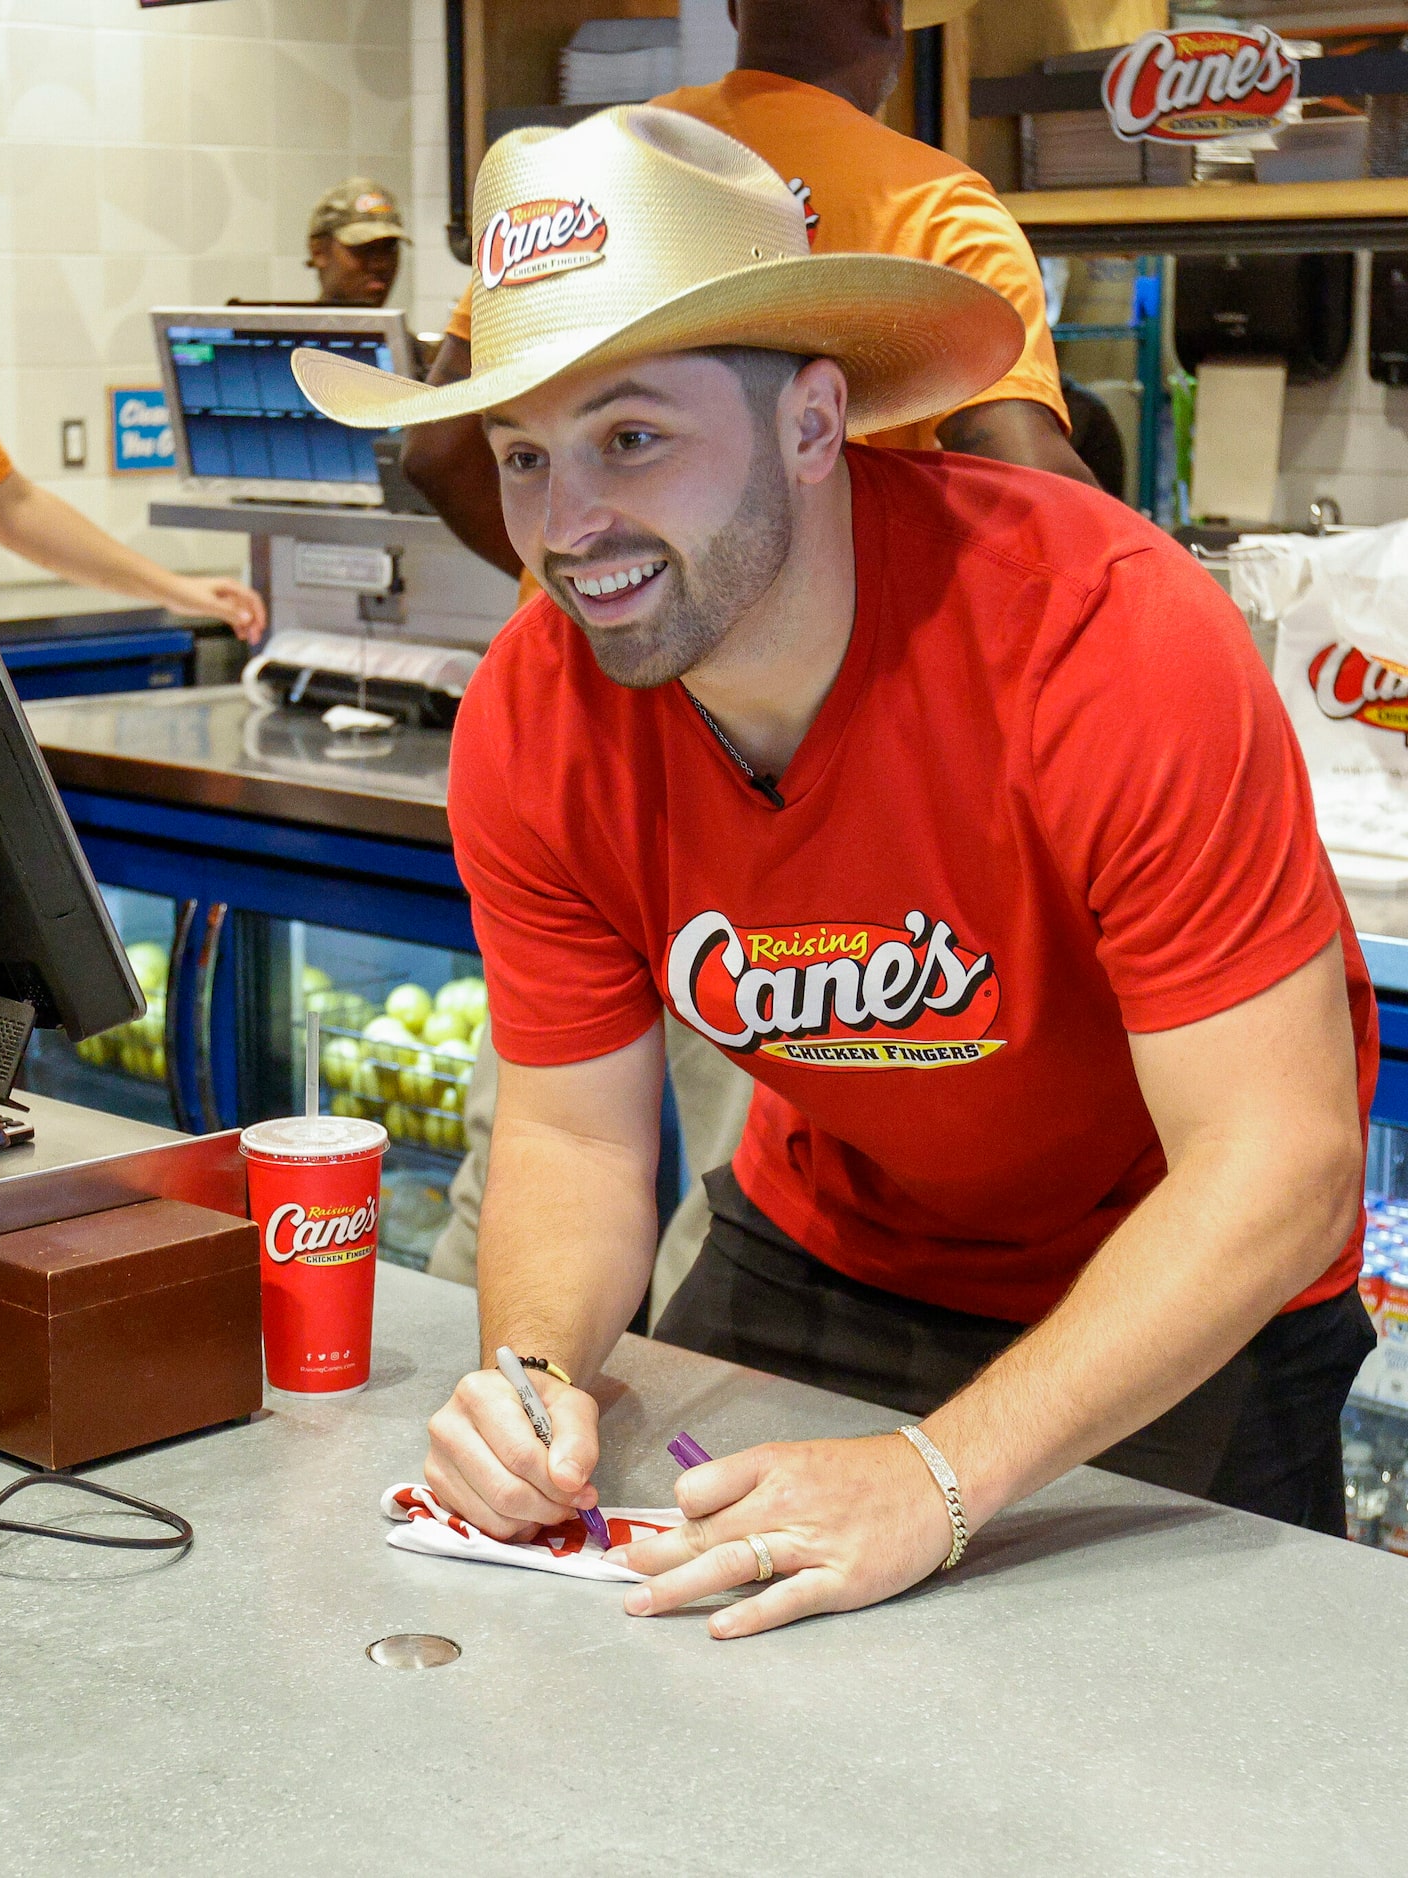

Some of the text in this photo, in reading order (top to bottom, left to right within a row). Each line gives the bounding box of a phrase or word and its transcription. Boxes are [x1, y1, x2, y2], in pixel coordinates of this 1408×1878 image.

[1113, 24, 1292, 134] Cane's
[512, 202, 558, 225] Raising
[482, 196, 605, 289] Cane's
[513, 263, 548, 278] CHICKEN
[550, 254, 591, 268] FINGERS
[747, 927, 869, 962] Raising
[667, 909, 992, 1050] Cane's
[785, 1044, 980, 1062] CHICKEN FINGERS
[307, 1204, 356, 1219] Raising
[265, 1195, 378, 1263] Cane's
[305, 1254, 343, 1264] CHICKEN
